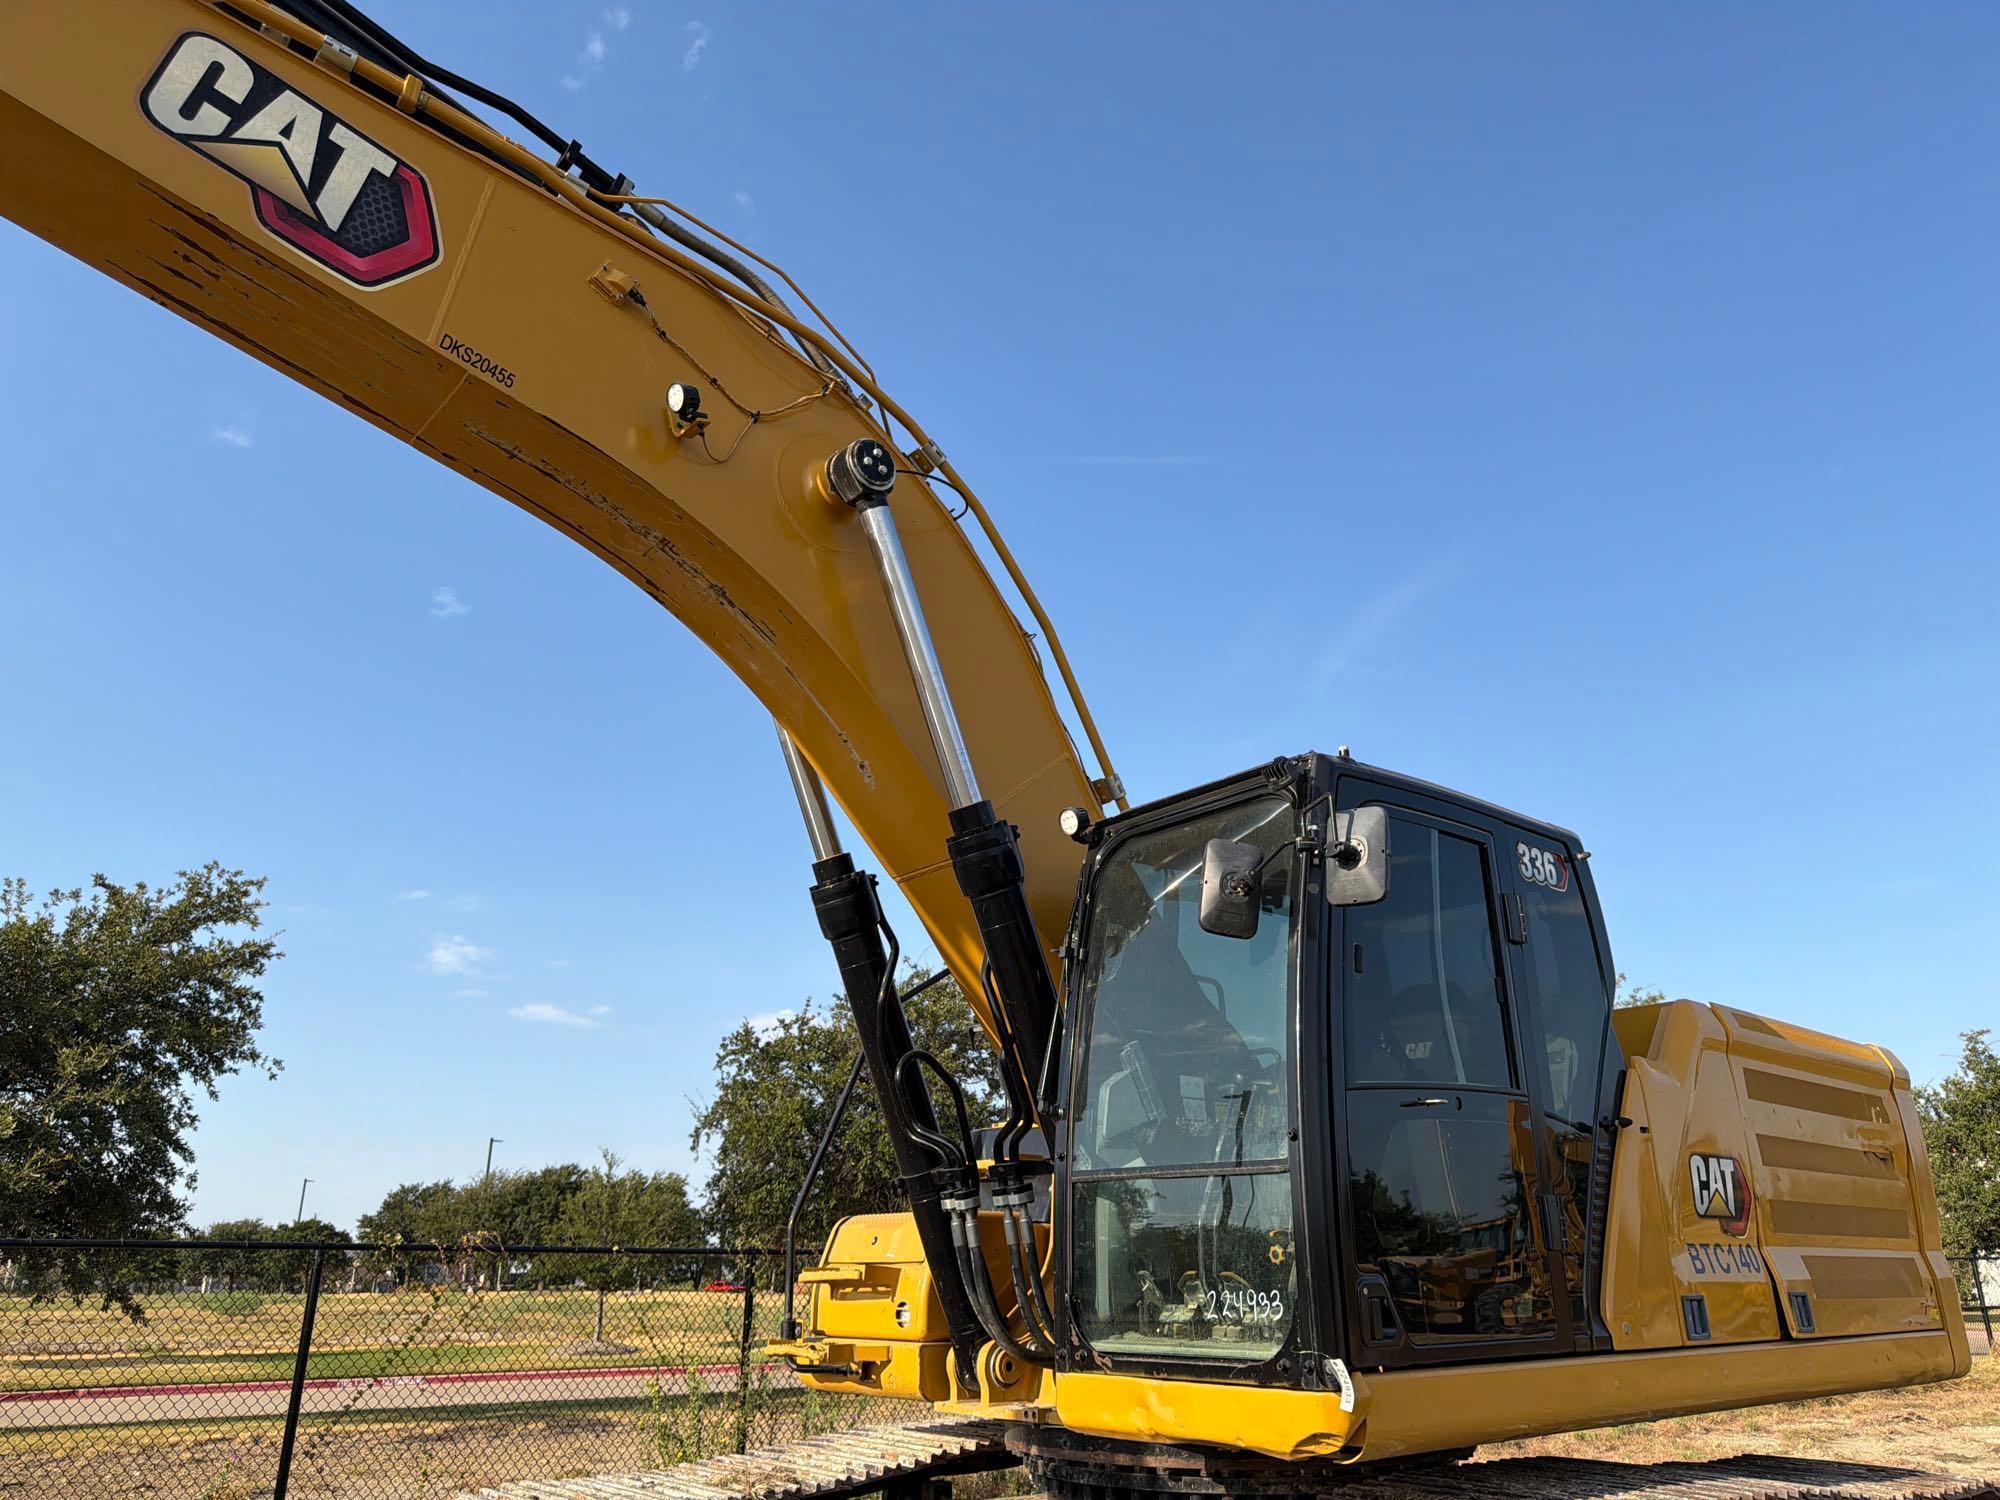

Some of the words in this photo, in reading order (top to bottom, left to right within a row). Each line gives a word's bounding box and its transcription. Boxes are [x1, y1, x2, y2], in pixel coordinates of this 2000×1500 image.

[148, 36, 398, 232] CAT
[439, 333, 516, 388] DKS20455
[1517, 842, 1557, 886] 336
[1405, 1041, 1434, 1059] CAT
[1690, 1154, 1736, 1217] CAT
[1686, 1243, 1761, 1274] BTC140
[1206, 1289, 1284, 1322] 224933
